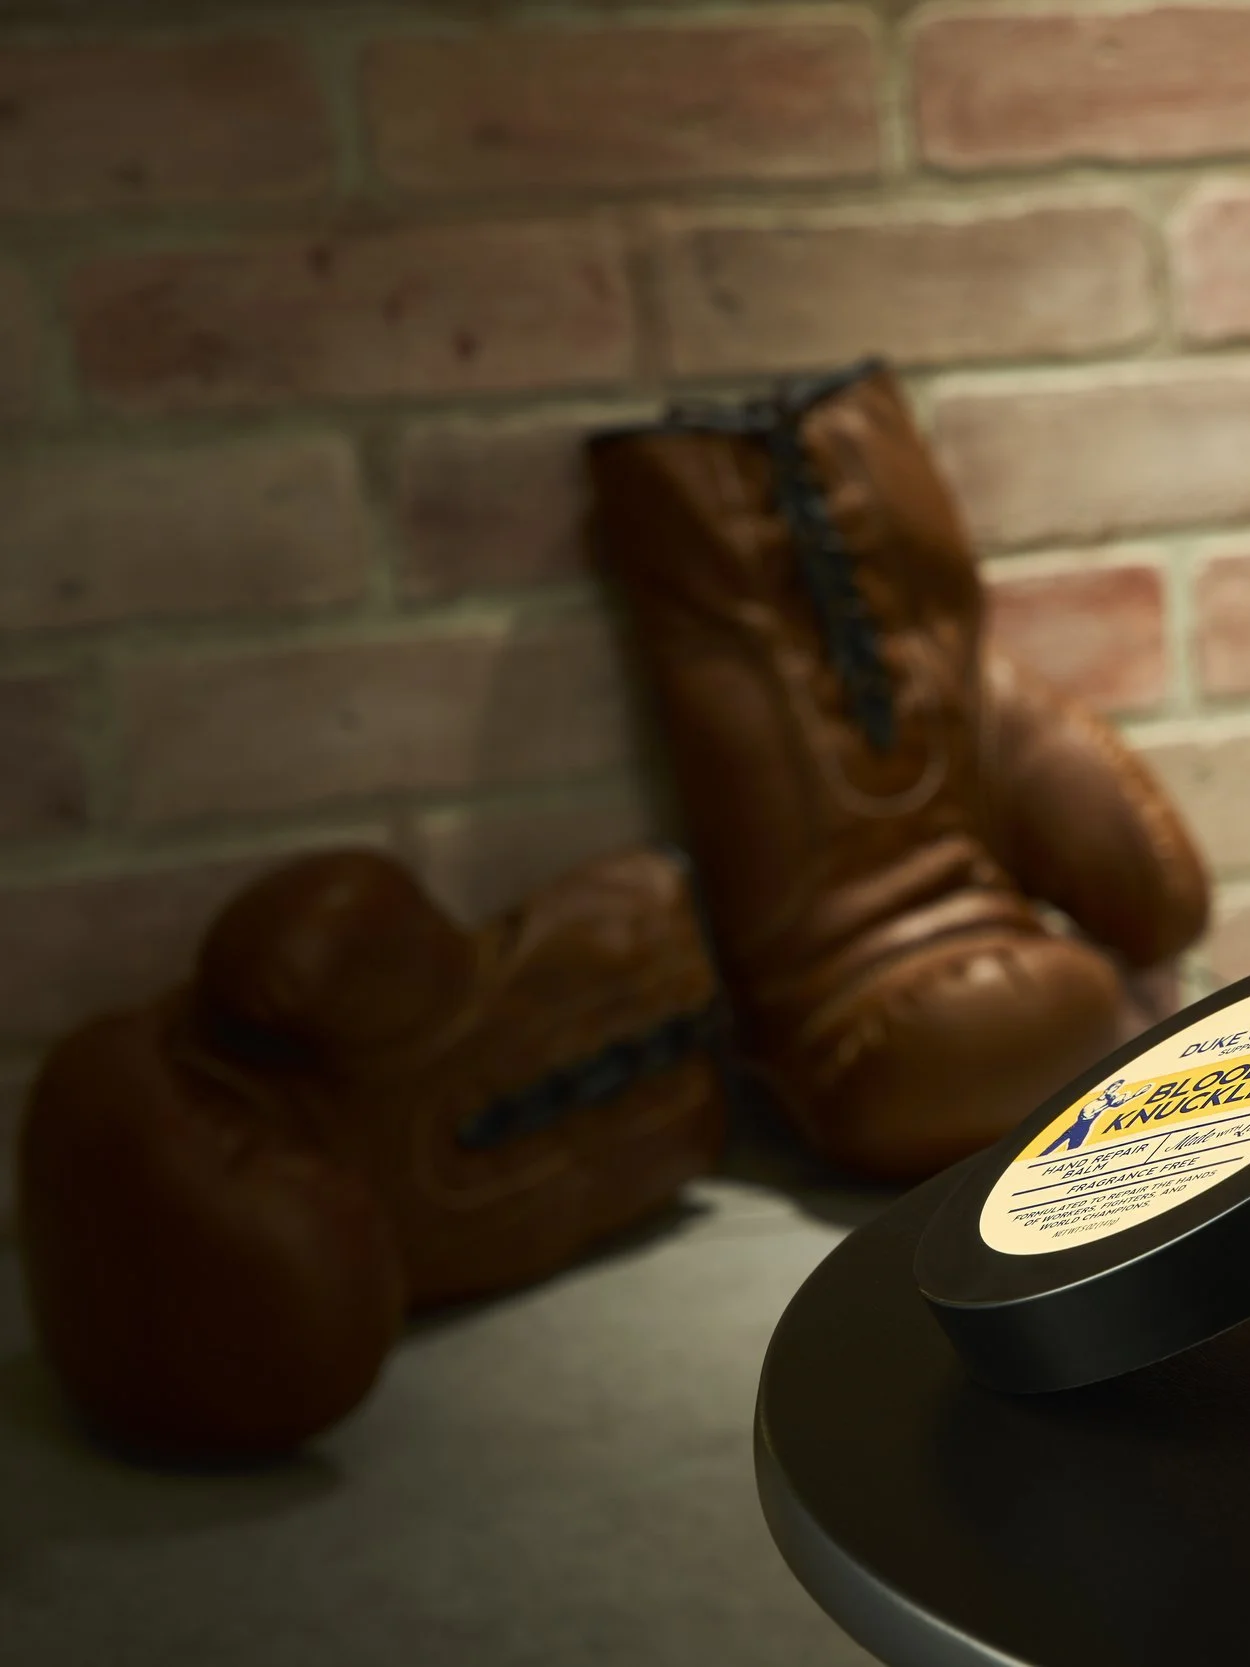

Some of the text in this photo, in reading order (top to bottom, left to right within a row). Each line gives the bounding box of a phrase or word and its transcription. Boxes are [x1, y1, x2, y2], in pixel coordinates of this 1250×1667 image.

[1179, 1031, 1248, 1058] DUKE
[1164, 1128, 1215, 1153] Made
[1217, 1124, 1243, 1138] WITH
[1042, 1143, 1149, 1177] HAND REPAIR
[1061, 1162, 1108, 1180] BALM
[1066, 1156, 1200, 1195] FRAGRANCE FREE
[1013, 1169, 1218, 1222] FORMULATED TO REPAIR THE HANDS
[1024, 1216, 1042, 1227] OF
[1159, 1184, 1187, 1197] AND
[1039, 1217, 1081, 1231] WORLD
